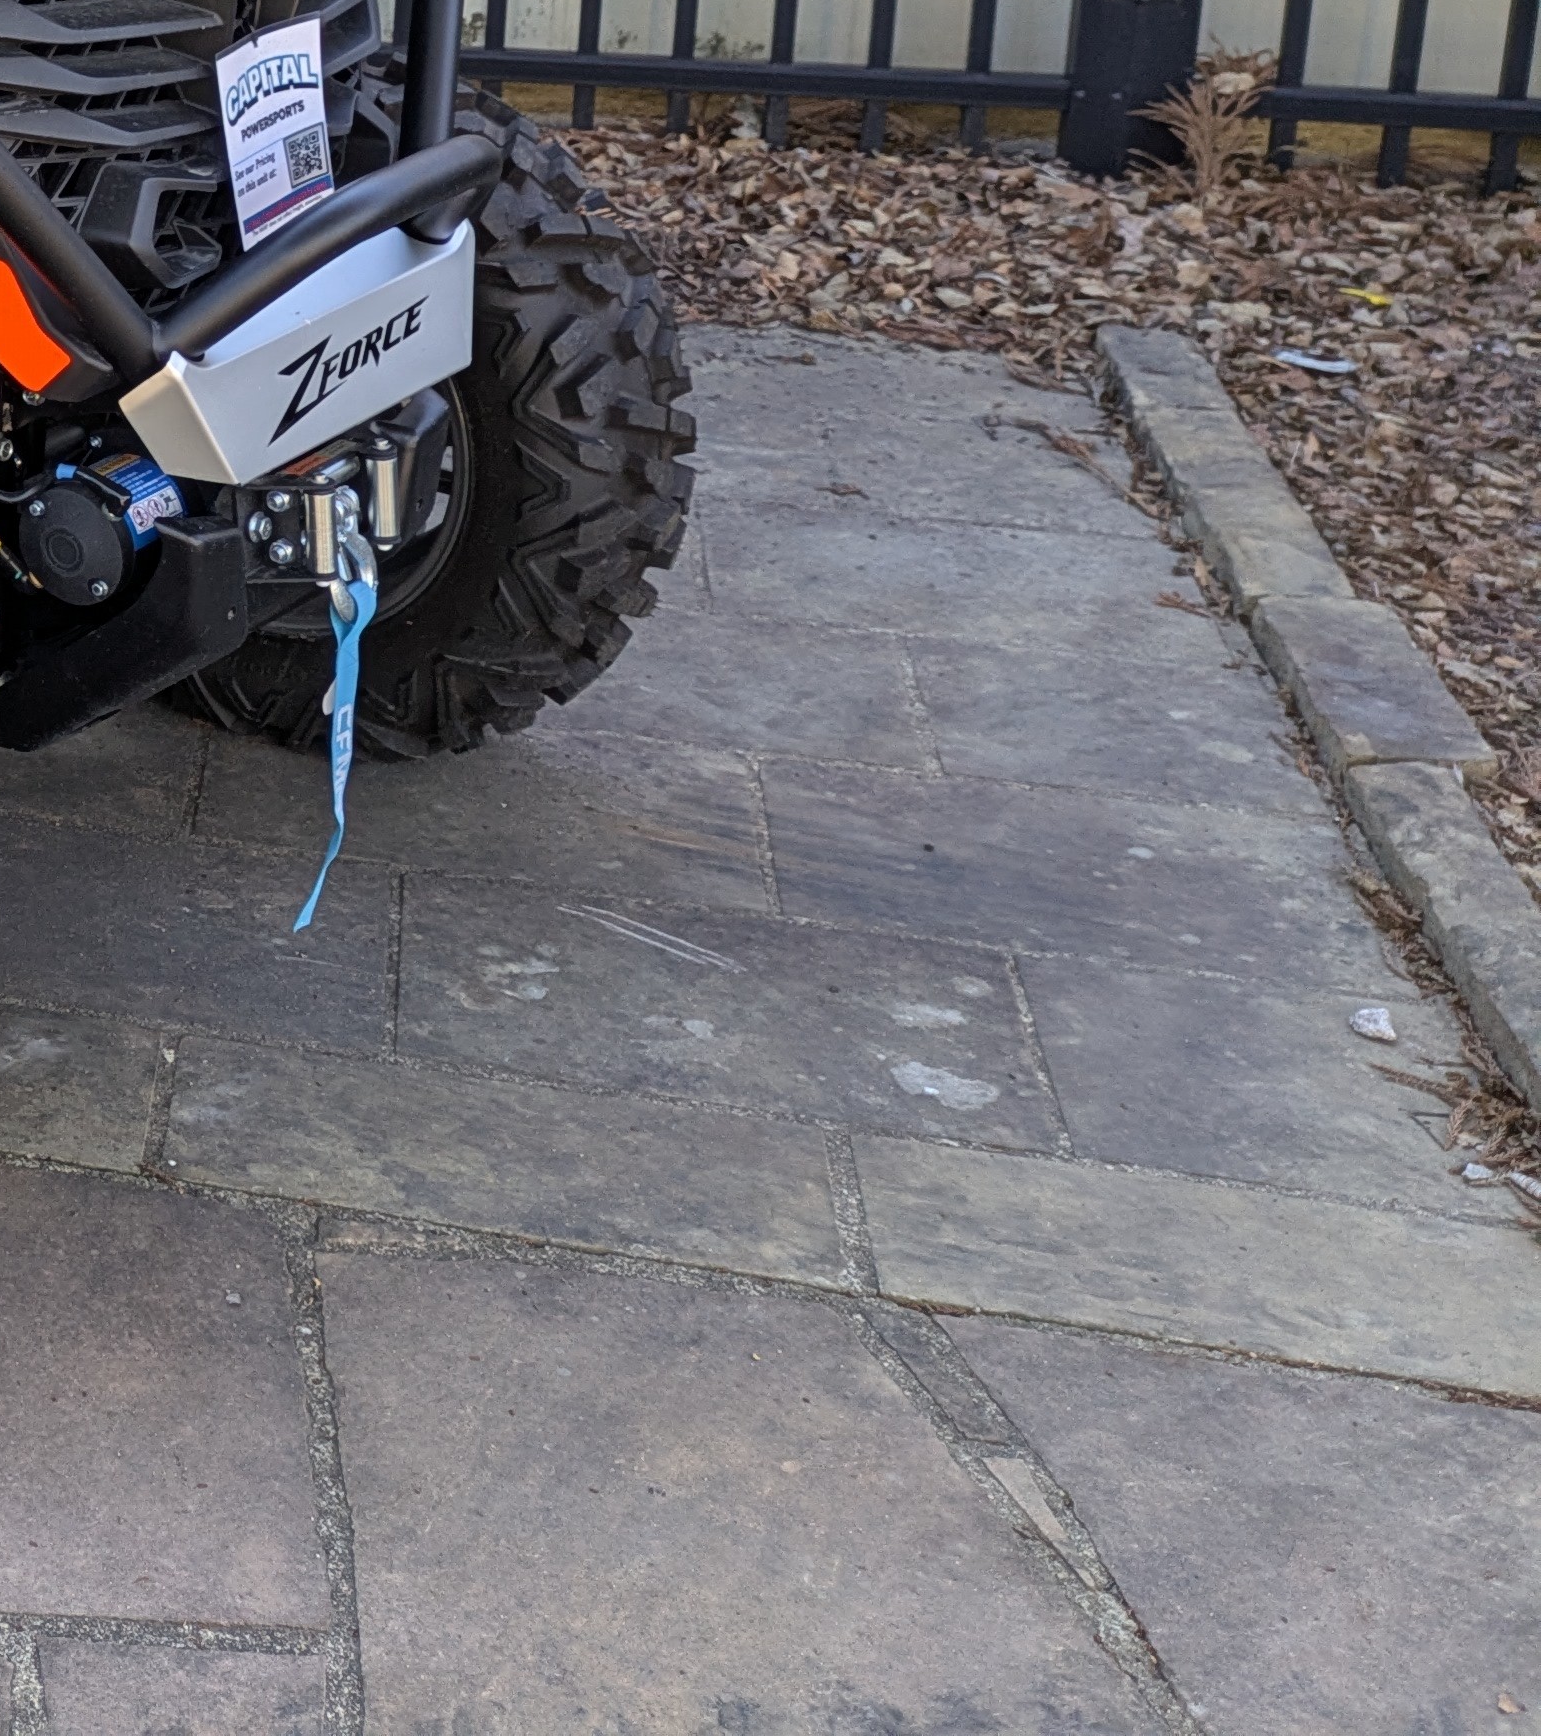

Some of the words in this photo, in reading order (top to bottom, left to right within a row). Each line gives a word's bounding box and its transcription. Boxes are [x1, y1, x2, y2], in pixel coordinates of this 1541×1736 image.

[225, 53, 319, 127] CAPITAL
[240, 99, 305, 142] POWERSPORTS
[267, 295, 430, 448] ZFORCE
